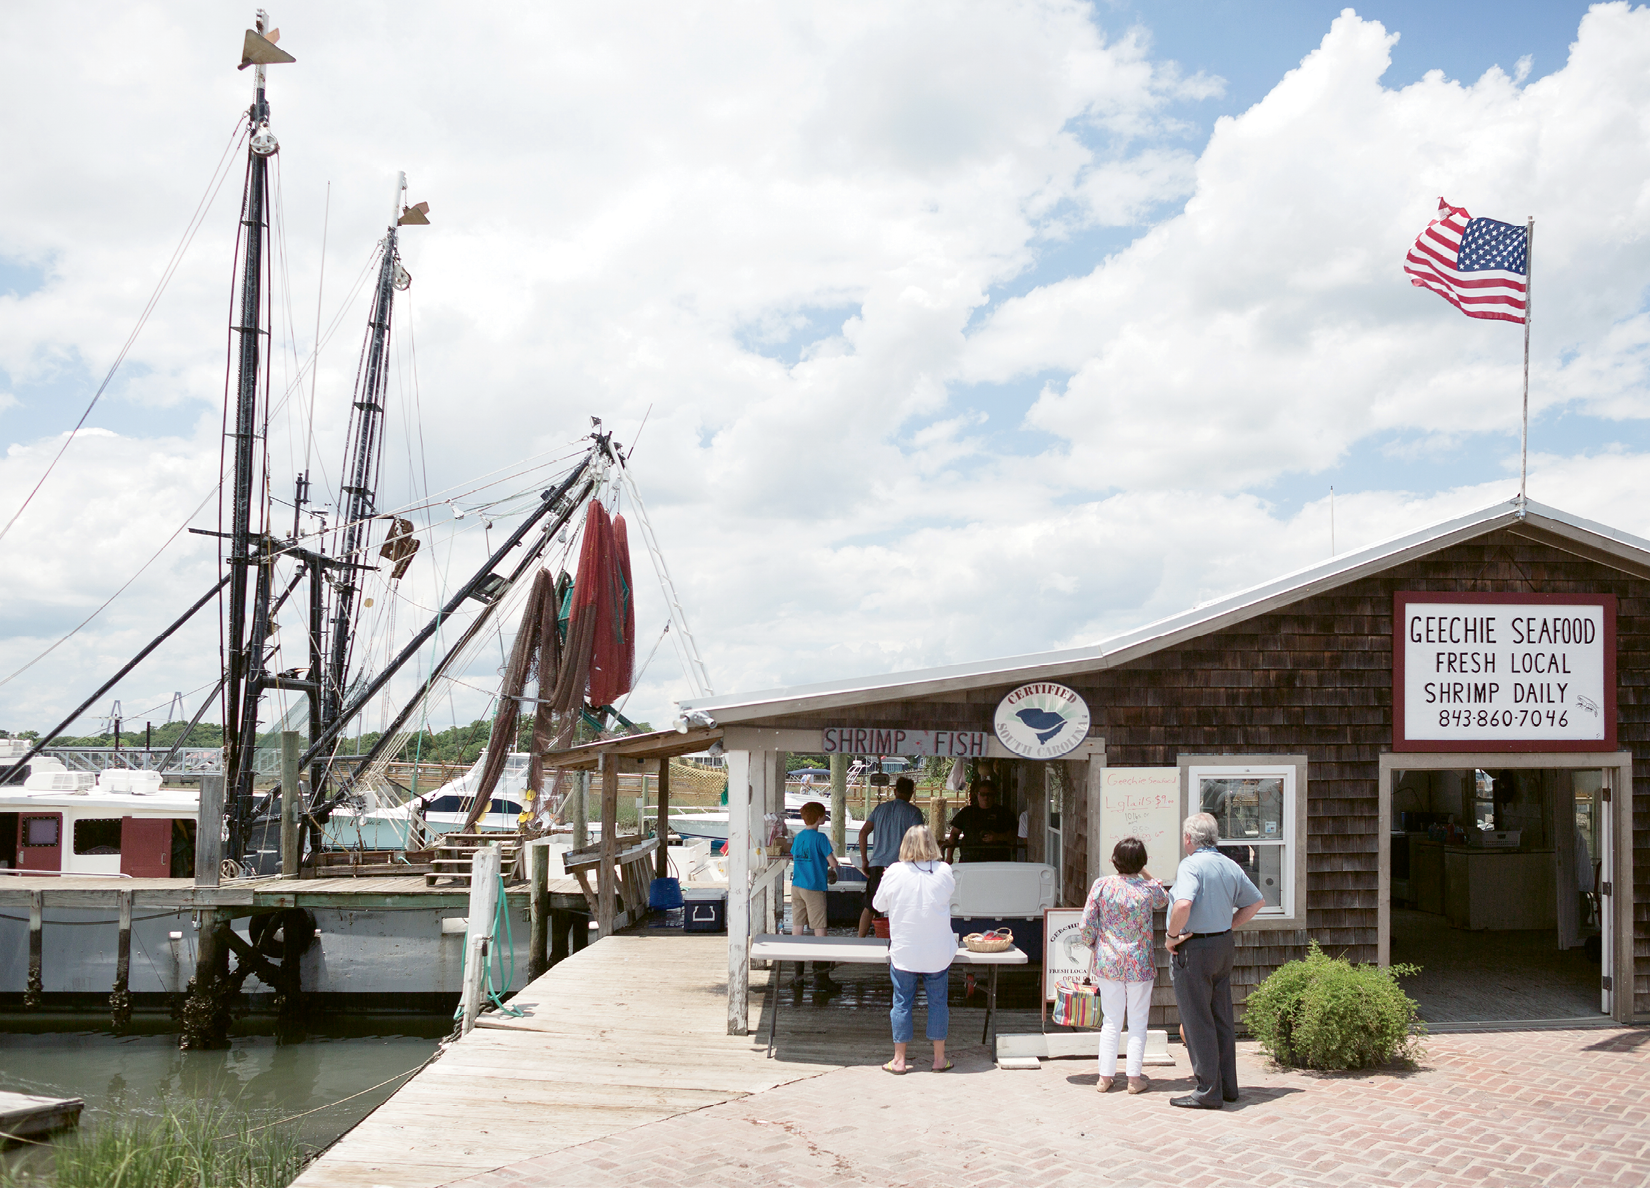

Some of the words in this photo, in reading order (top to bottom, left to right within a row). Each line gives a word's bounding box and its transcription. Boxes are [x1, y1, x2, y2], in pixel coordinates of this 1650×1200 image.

[1410, 616, 1496, 643] GEECHIE
[1512, 617, 1595, 644] SEAFOOD
[1436, 652, 1496, 673] FRESH
[1511, 653, 1571, 673] LOCAL
[1007, 684, 1077, 705] CERTIFIED
[1424, 682, 1500, 703] SHRIMP
[1514, 682, 1568, 703] DAILY
[824, 729, 906, 753] SHRIMP
[934, 731, 983, 756] FISH
[997, 722, 1033, 756] SOUTH
[1036, 721, 1088, 757] CAROLINA
[1107, 773, 1147, 786] Geechie
[1148, 776, 1177, 785] Seafood
